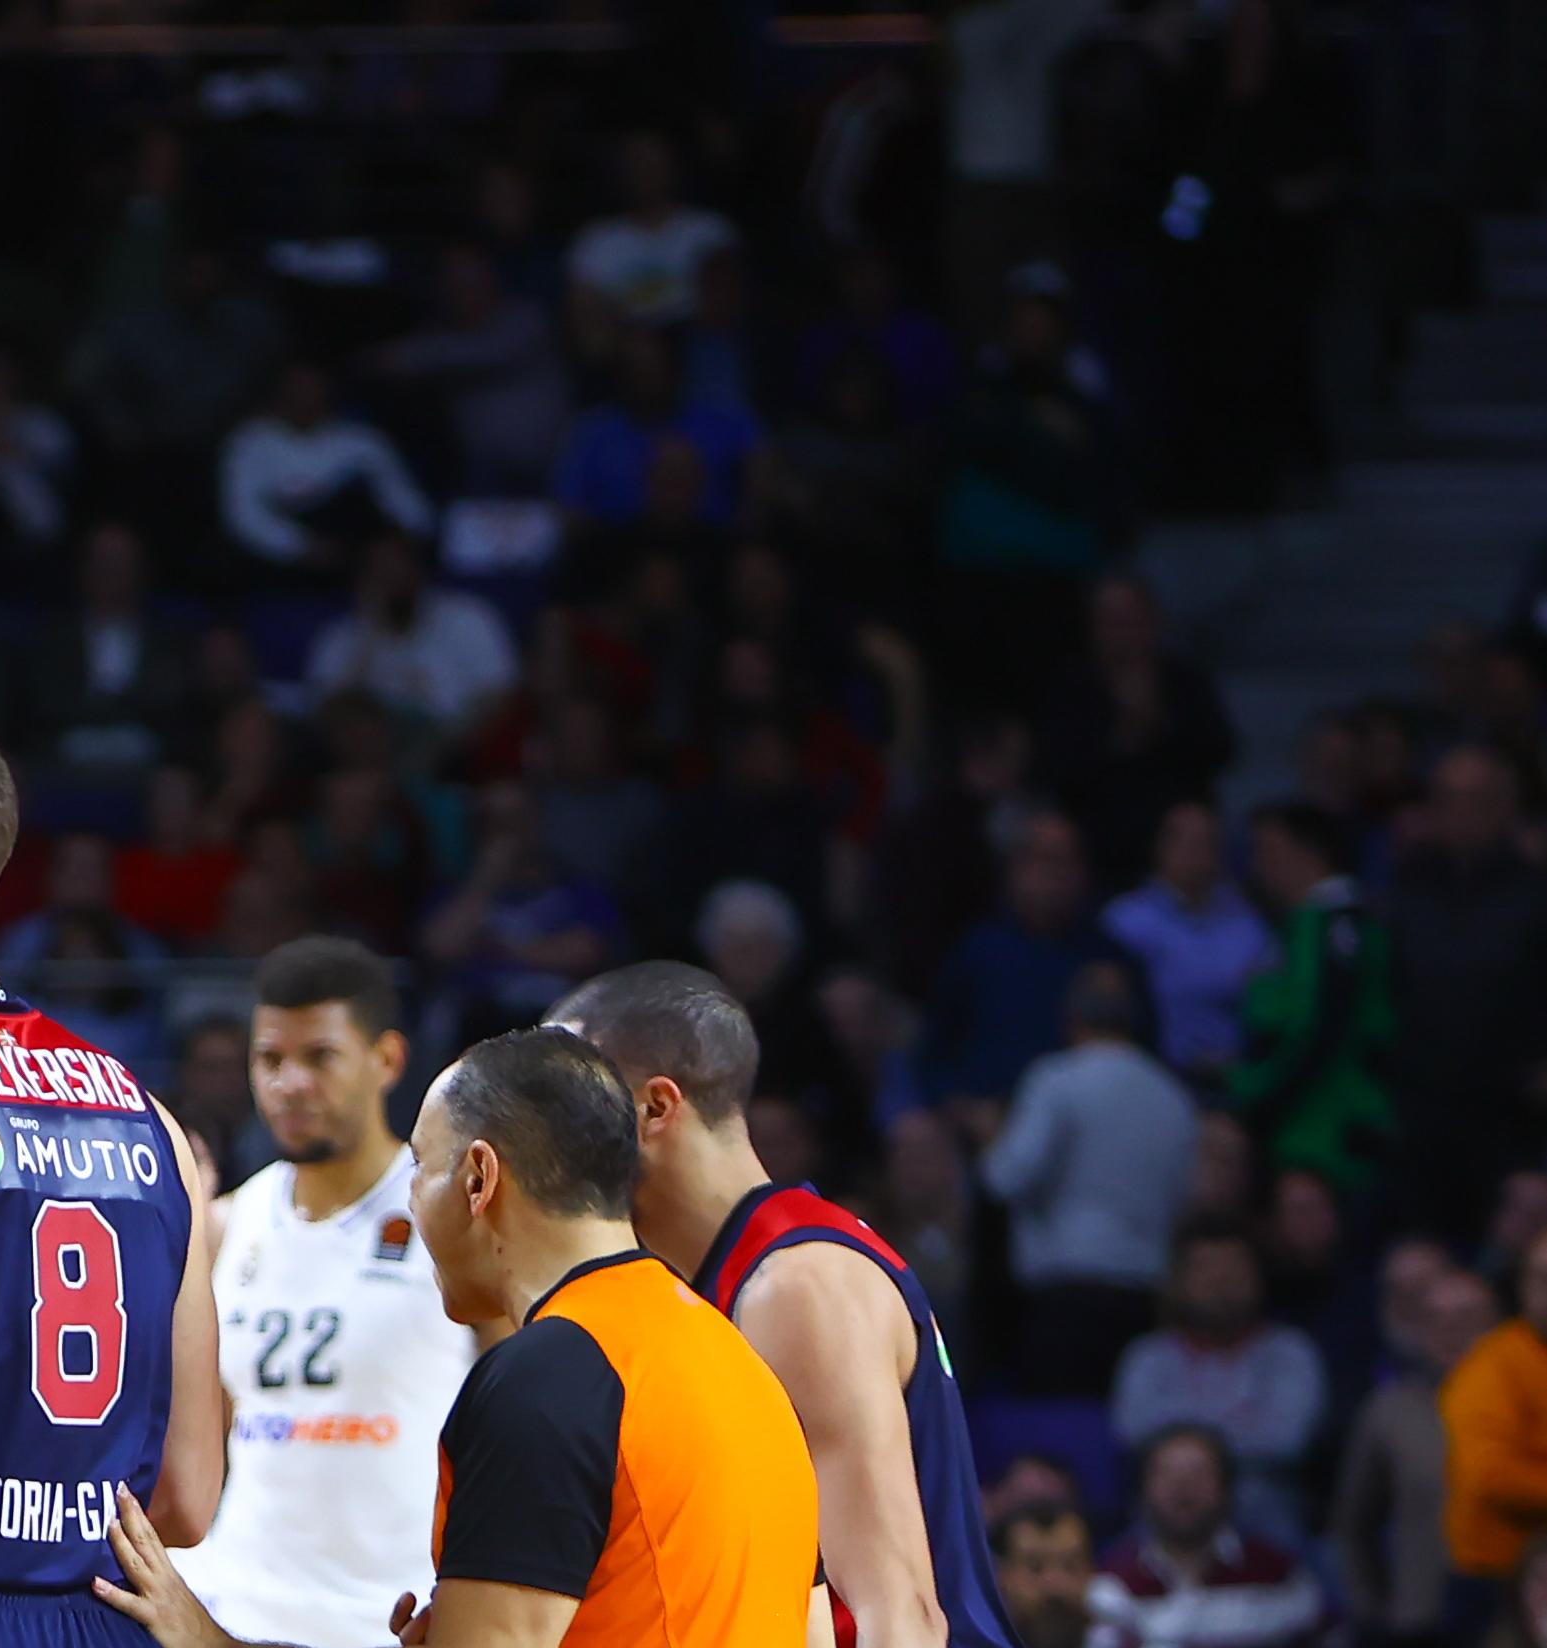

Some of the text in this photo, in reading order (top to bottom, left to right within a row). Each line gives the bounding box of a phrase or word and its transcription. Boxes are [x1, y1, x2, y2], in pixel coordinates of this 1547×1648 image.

[9, 1116, 40, 1131] GRUPO
[15, 1132, 158, 1186] AMUTIO
[32, 1200, 127, 1425] 8
[256, 1309, 340, 1388] 22
